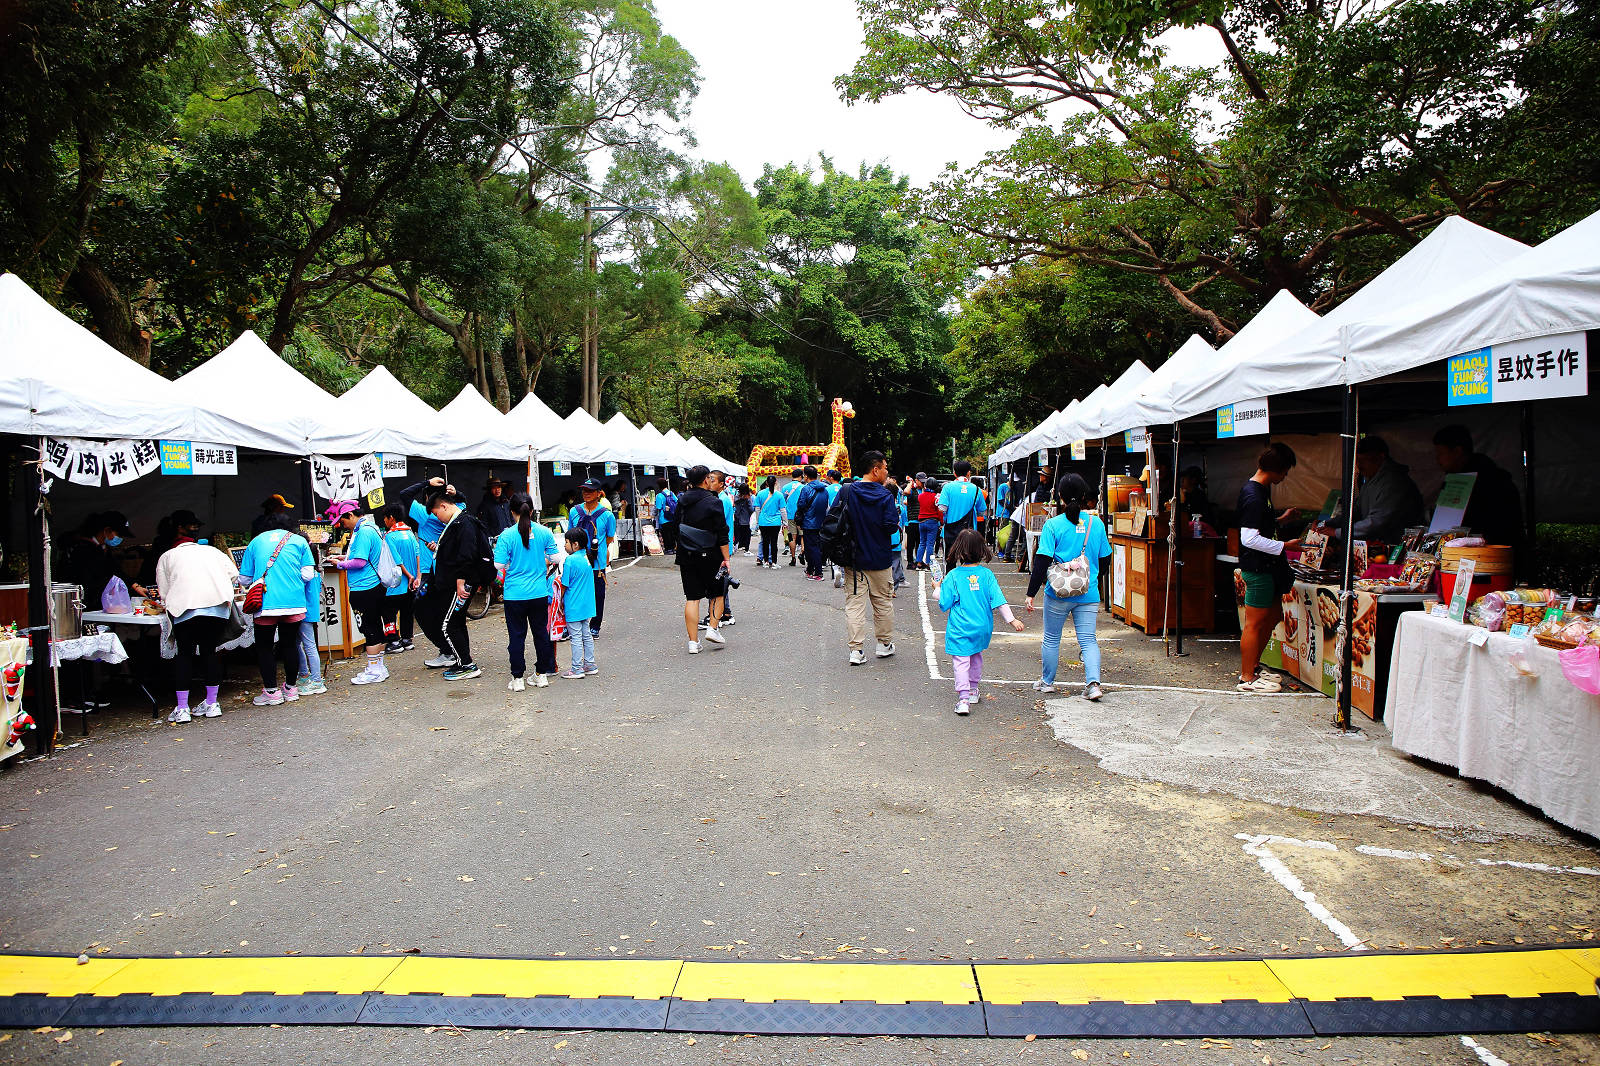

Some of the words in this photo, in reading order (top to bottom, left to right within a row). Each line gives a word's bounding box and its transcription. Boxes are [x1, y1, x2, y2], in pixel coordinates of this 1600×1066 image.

[1451, 355, 1488, 372] MIAOLI
[1497, 348, 1579, 383] 昱妏手作
[1453, 371, 1475, 384] FUN
[1451, 382, 1489, 397] YOUNG
[162, 444, 190, 453] MIAOLI
[163, 461, 191, 469] YOUNG
